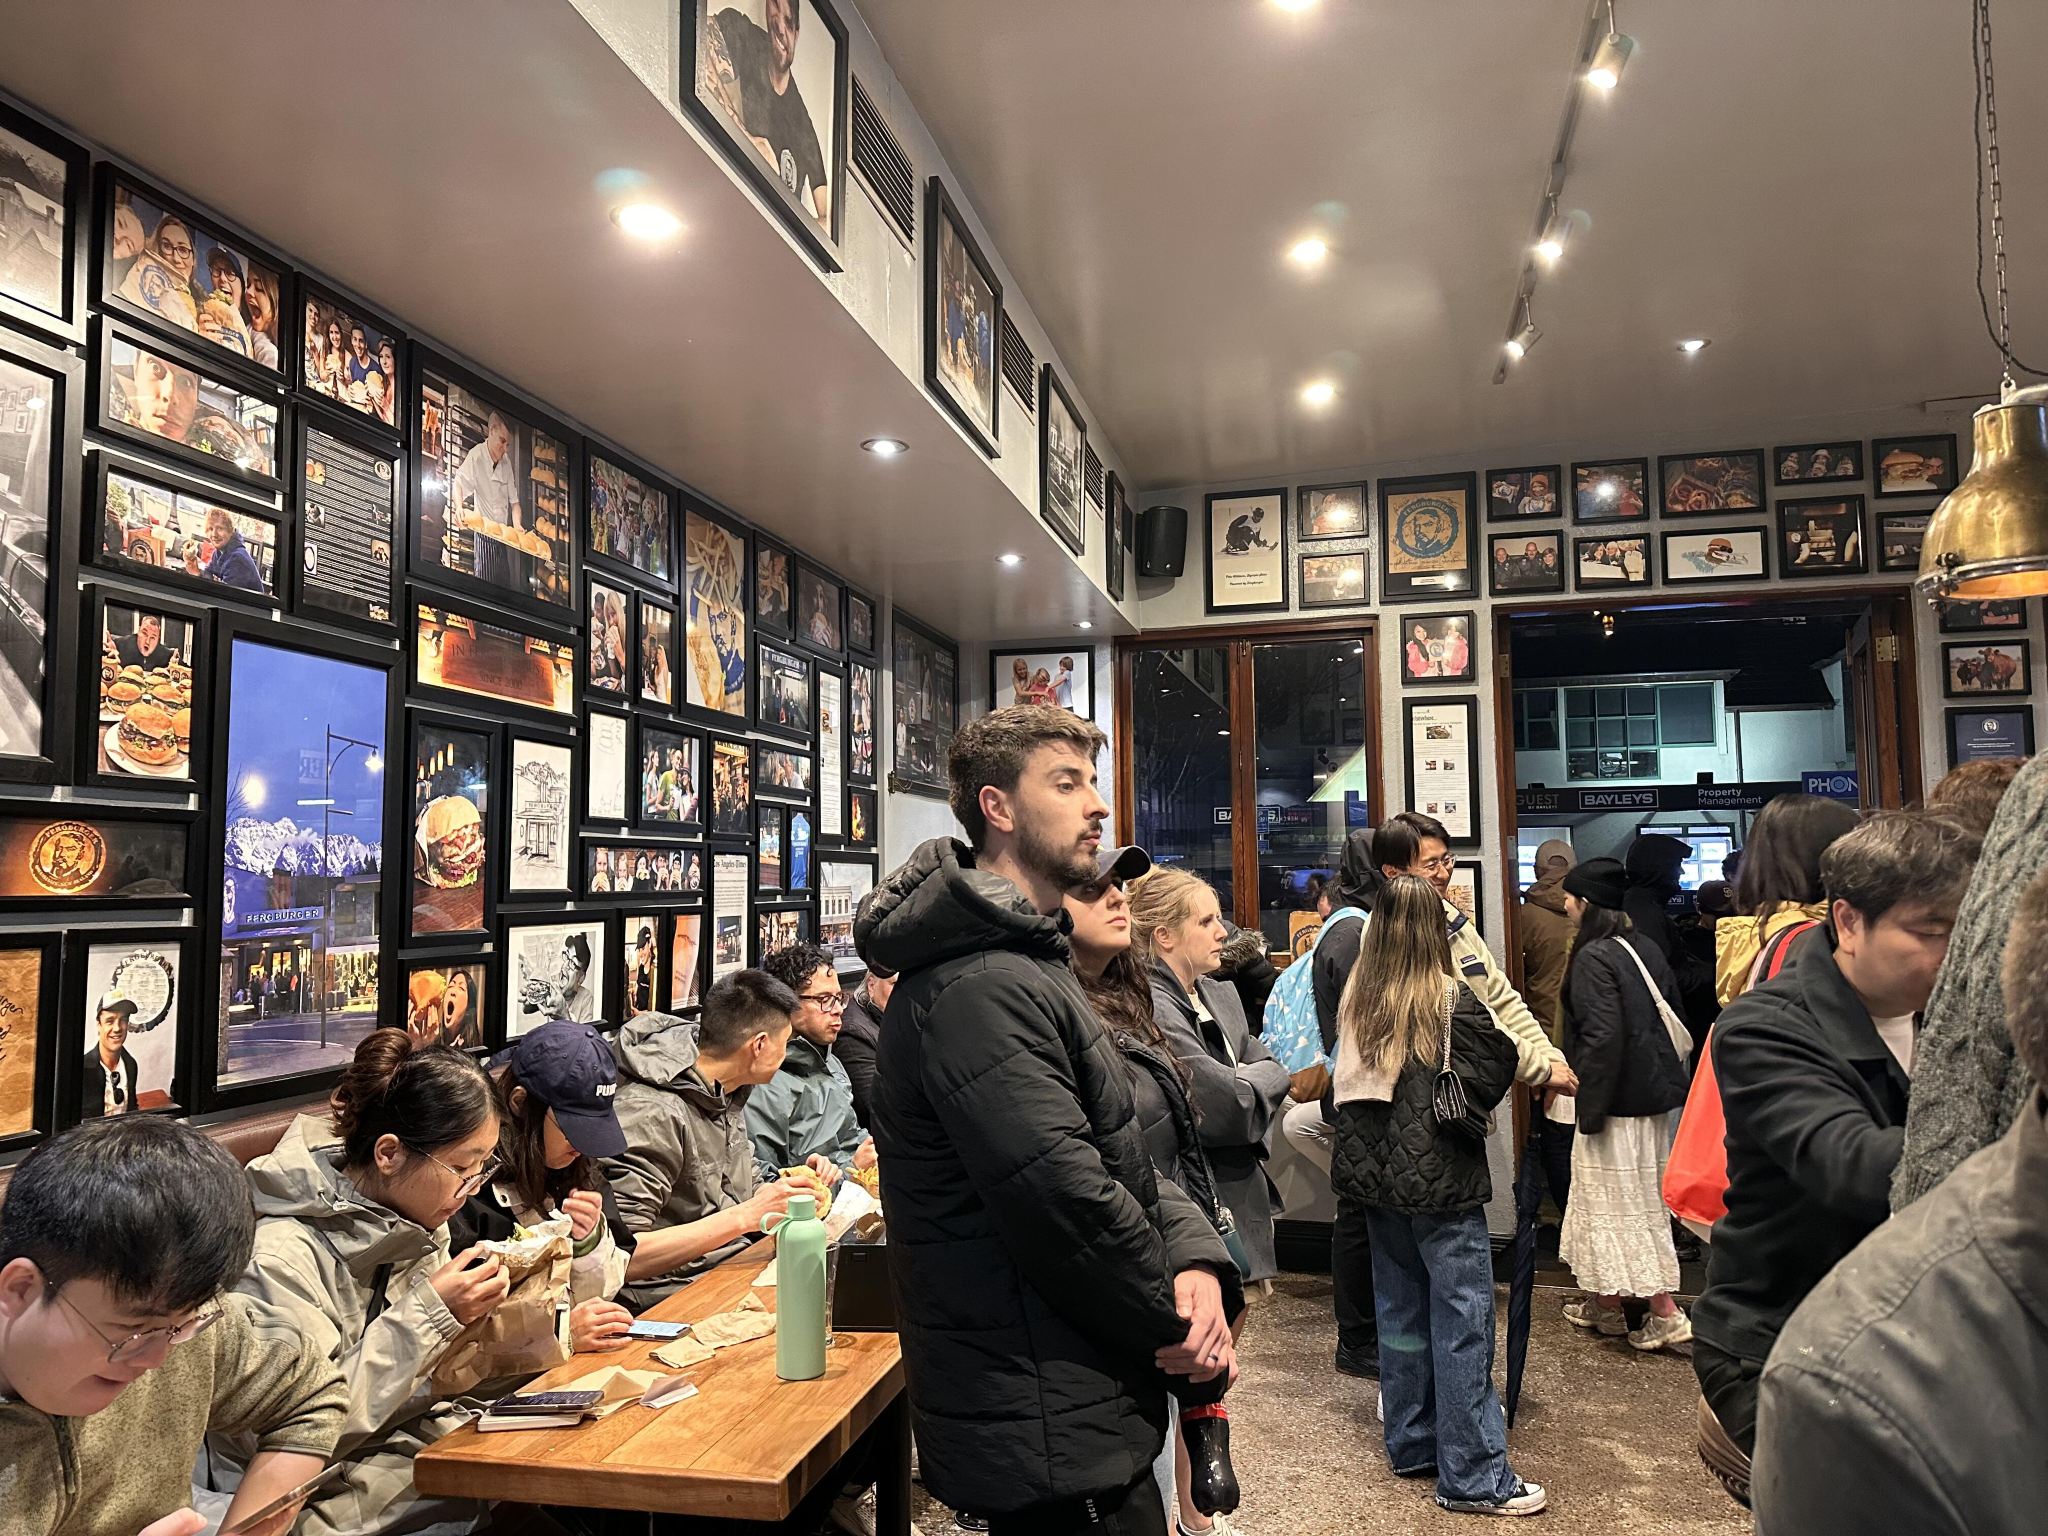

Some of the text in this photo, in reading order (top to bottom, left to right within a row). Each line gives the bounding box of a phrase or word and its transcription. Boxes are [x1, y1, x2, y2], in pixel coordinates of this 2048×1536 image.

[1698, 788, 1742, 797] Property
[1584, 792, 1654, 806] BAYLEYS
[1698, 796, 1763, 805] Management
[245, 908, 320, 924] FERGBURGER
